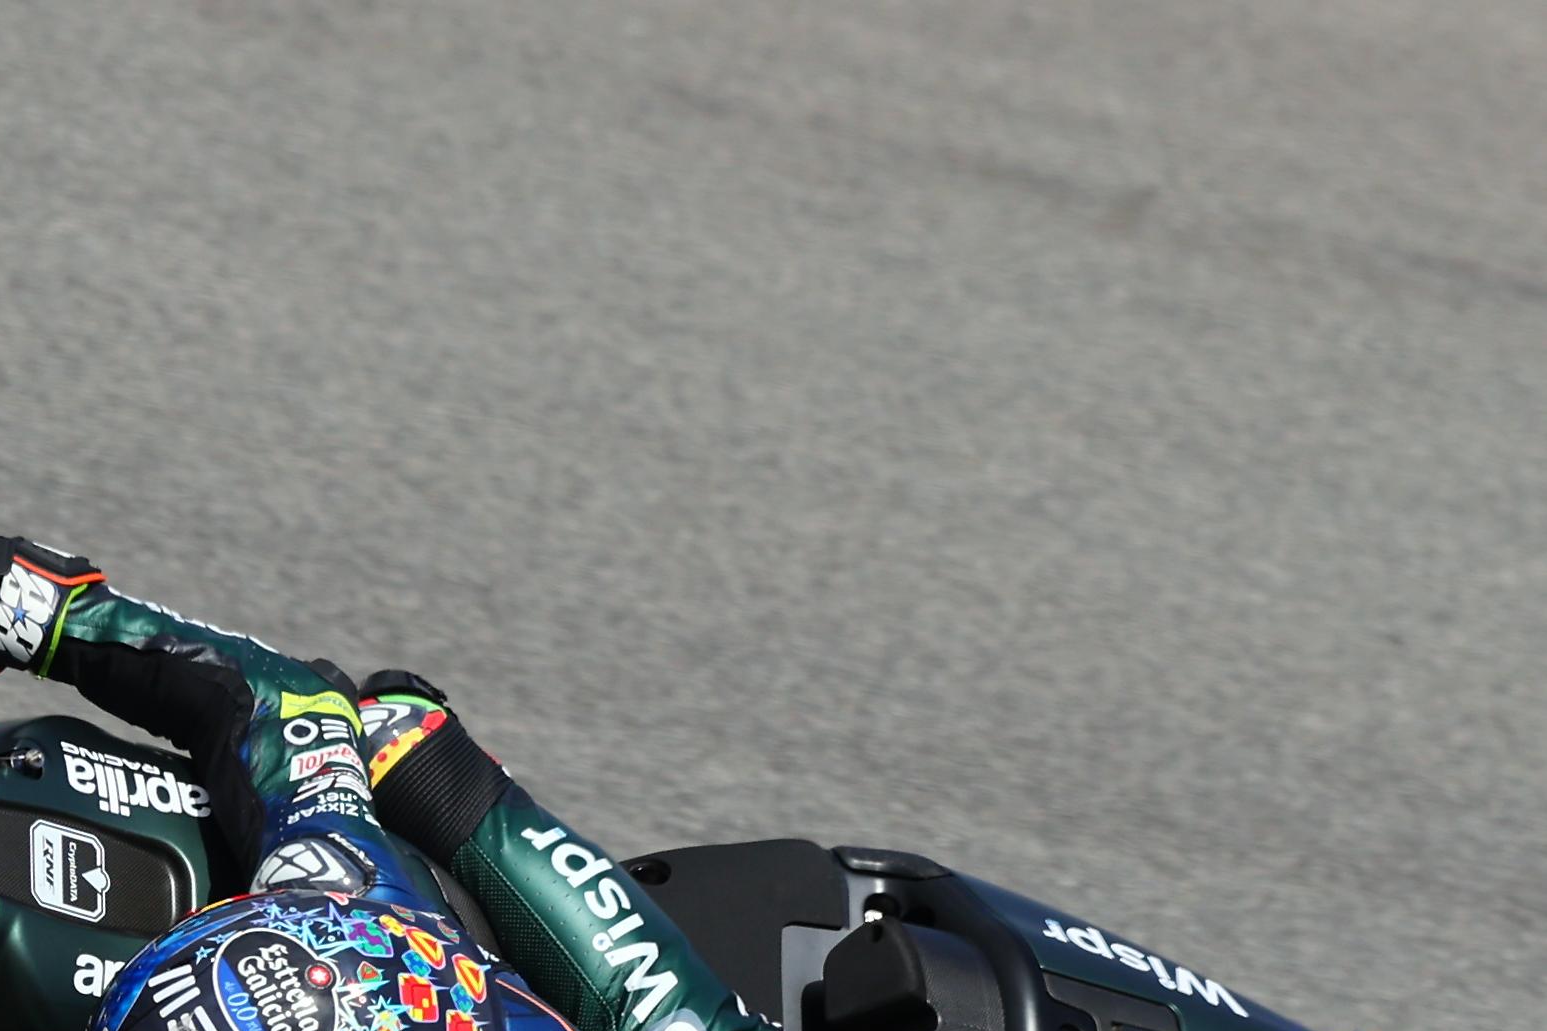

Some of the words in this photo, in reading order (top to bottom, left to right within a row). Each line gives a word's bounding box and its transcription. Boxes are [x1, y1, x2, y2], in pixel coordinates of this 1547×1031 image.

[60, 741, 160, 775] RACING
[283, 718, 358, 750] EO
[64, 754, 211, 818] aprilia
[520, 826, 679, 1024] Wispr
[1043, 917, 1250, 1018] Wispr
